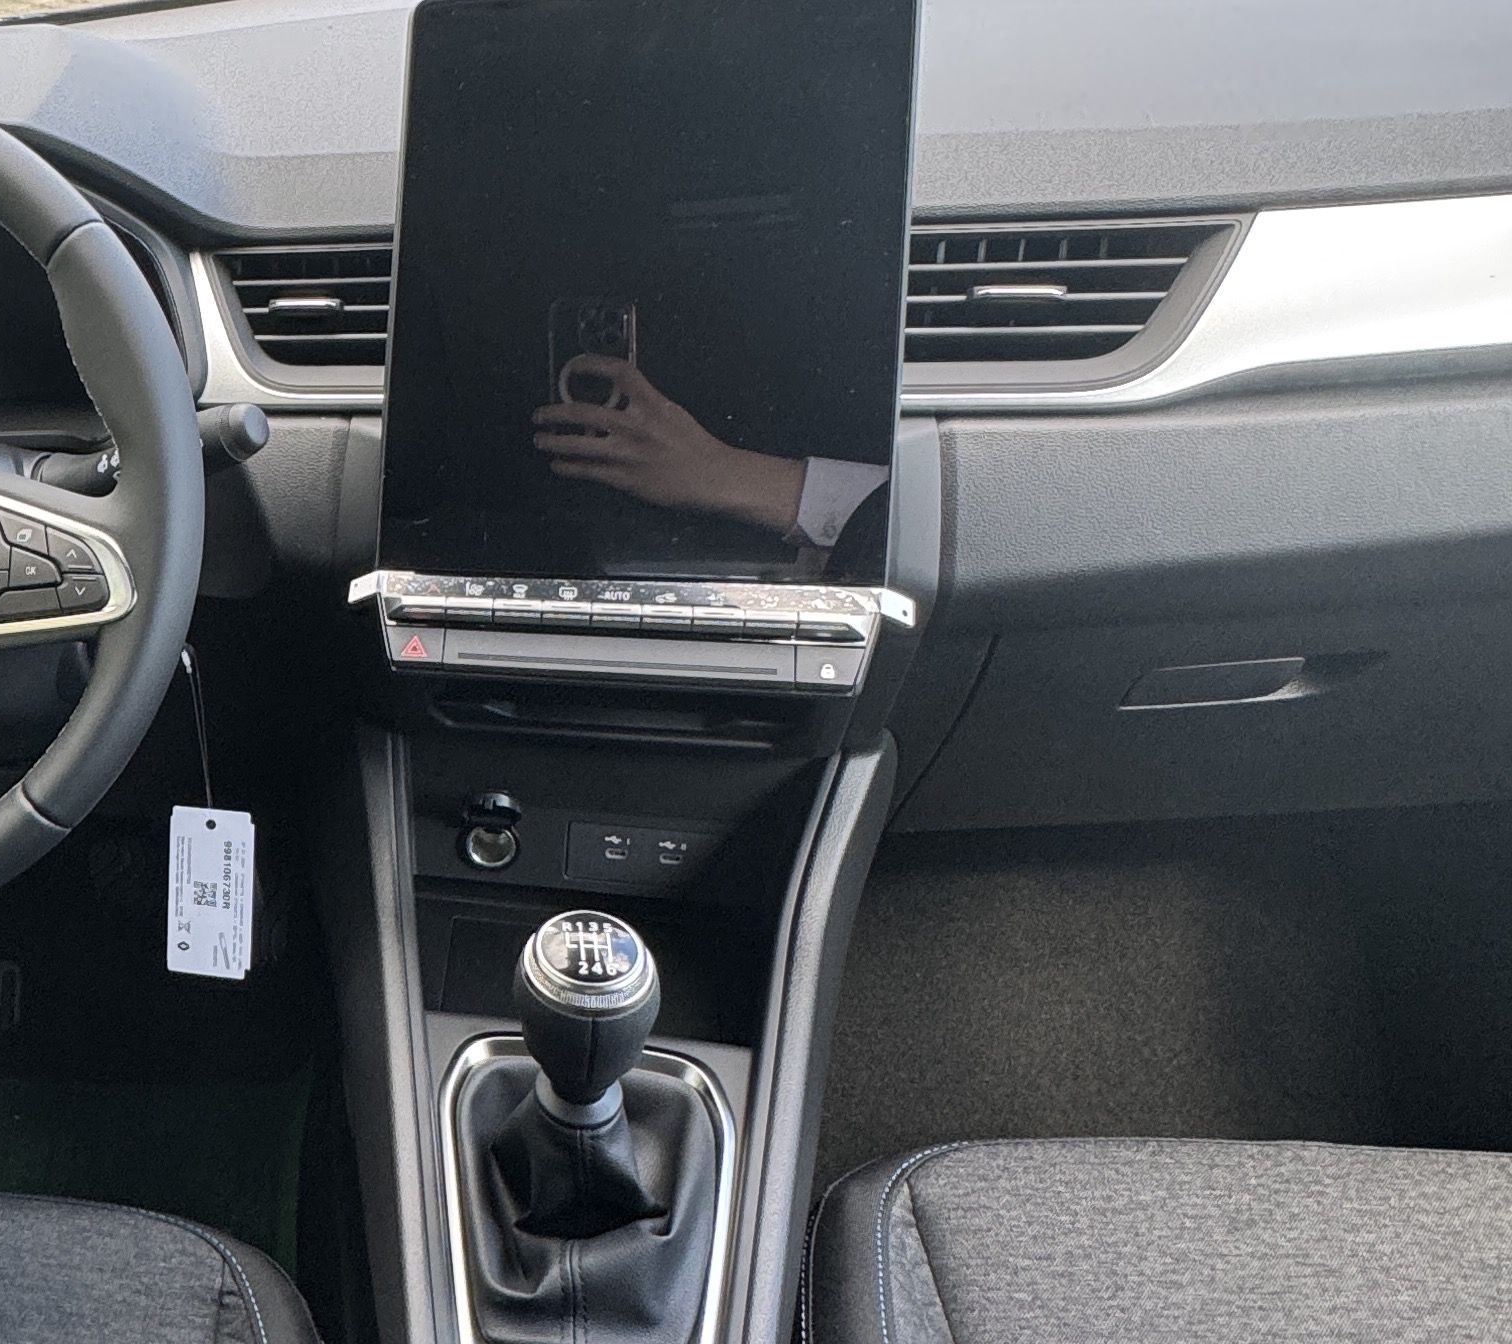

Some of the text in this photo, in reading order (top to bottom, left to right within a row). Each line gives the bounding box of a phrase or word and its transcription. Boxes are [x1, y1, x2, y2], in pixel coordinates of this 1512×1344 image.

[603, 590, 632, 601] AUTO
[561, 921, 572, 932] R
[589, 921, 598, 932] 3
[578, 962, 617, 976] 2 4 6
